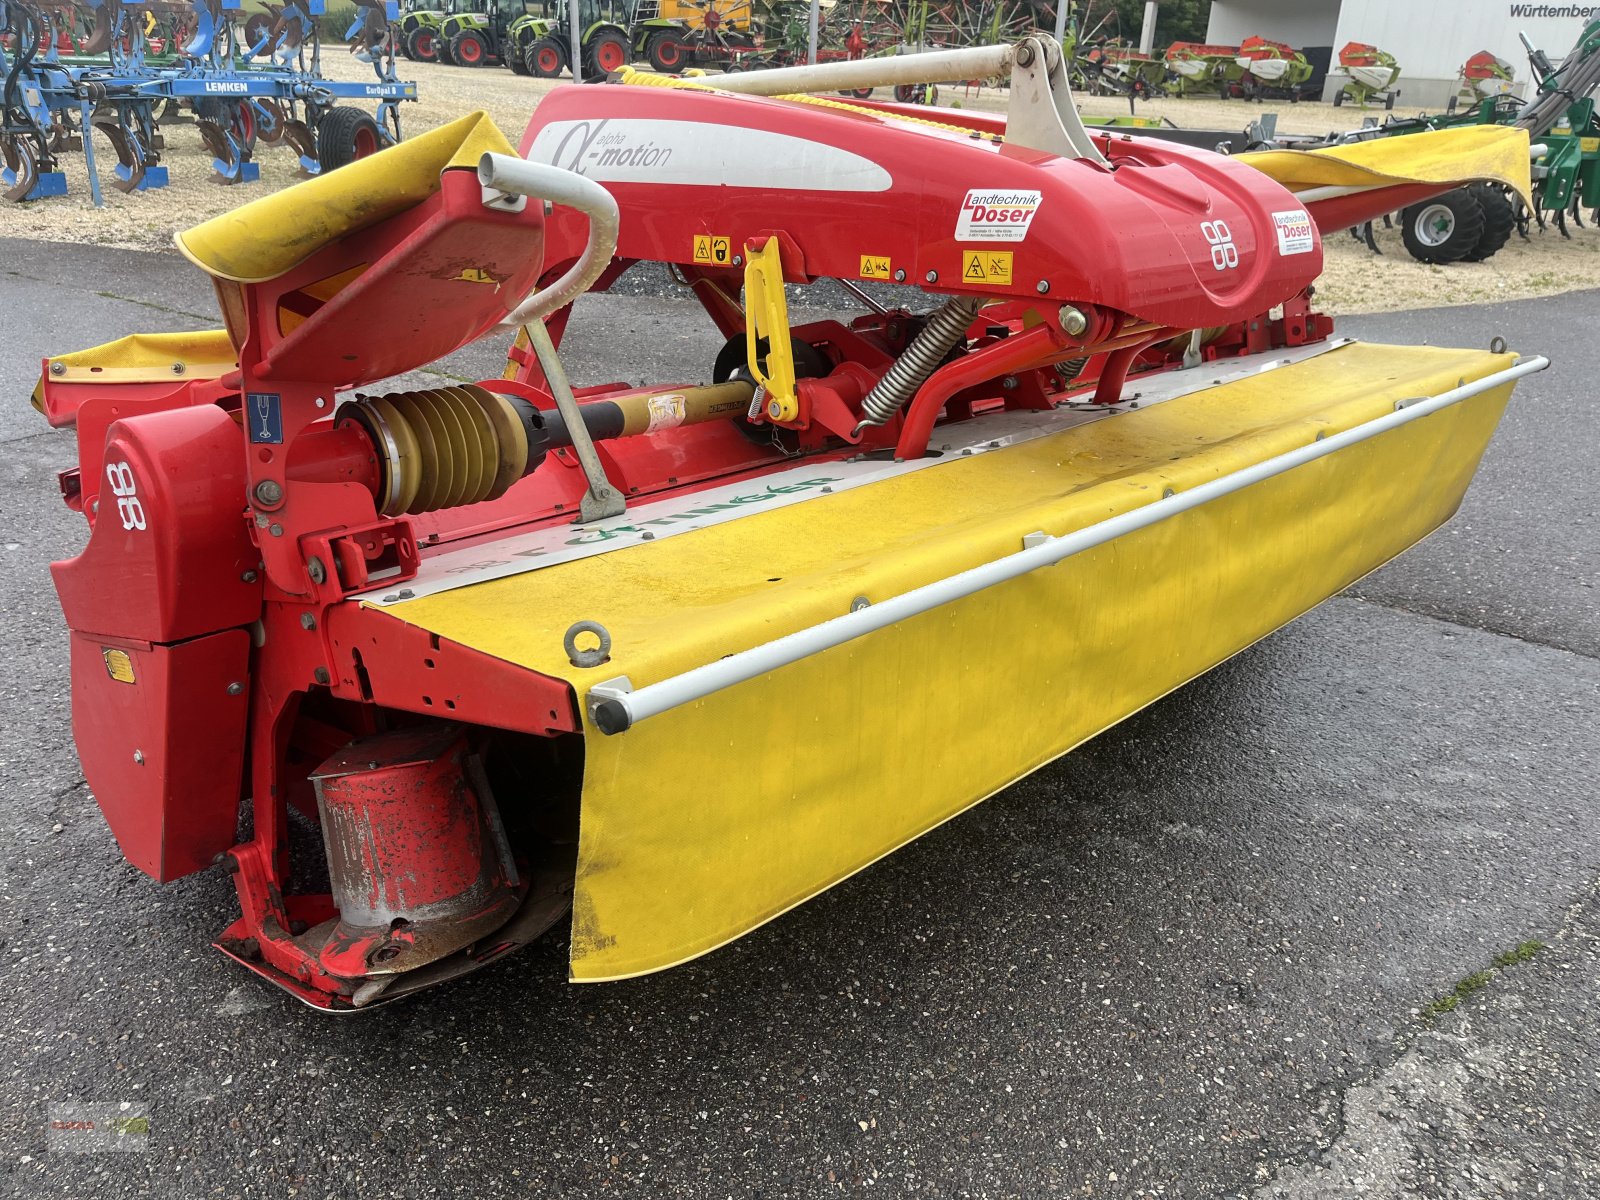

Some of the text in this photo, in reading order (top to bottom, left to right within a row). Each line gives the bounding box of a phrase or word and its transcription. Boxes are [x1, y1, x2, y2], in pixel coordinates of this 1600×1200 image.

[1510, 4, 1600, 18] Württember
[205, 82, 248, 93] LEMKEN
[596, 131, 626, 147] alpha
[963, 193, 1038, 210] Landtechnik
[971, 205, 1034, 223] Doser
[1282, 224, 1310, 238] Doser
